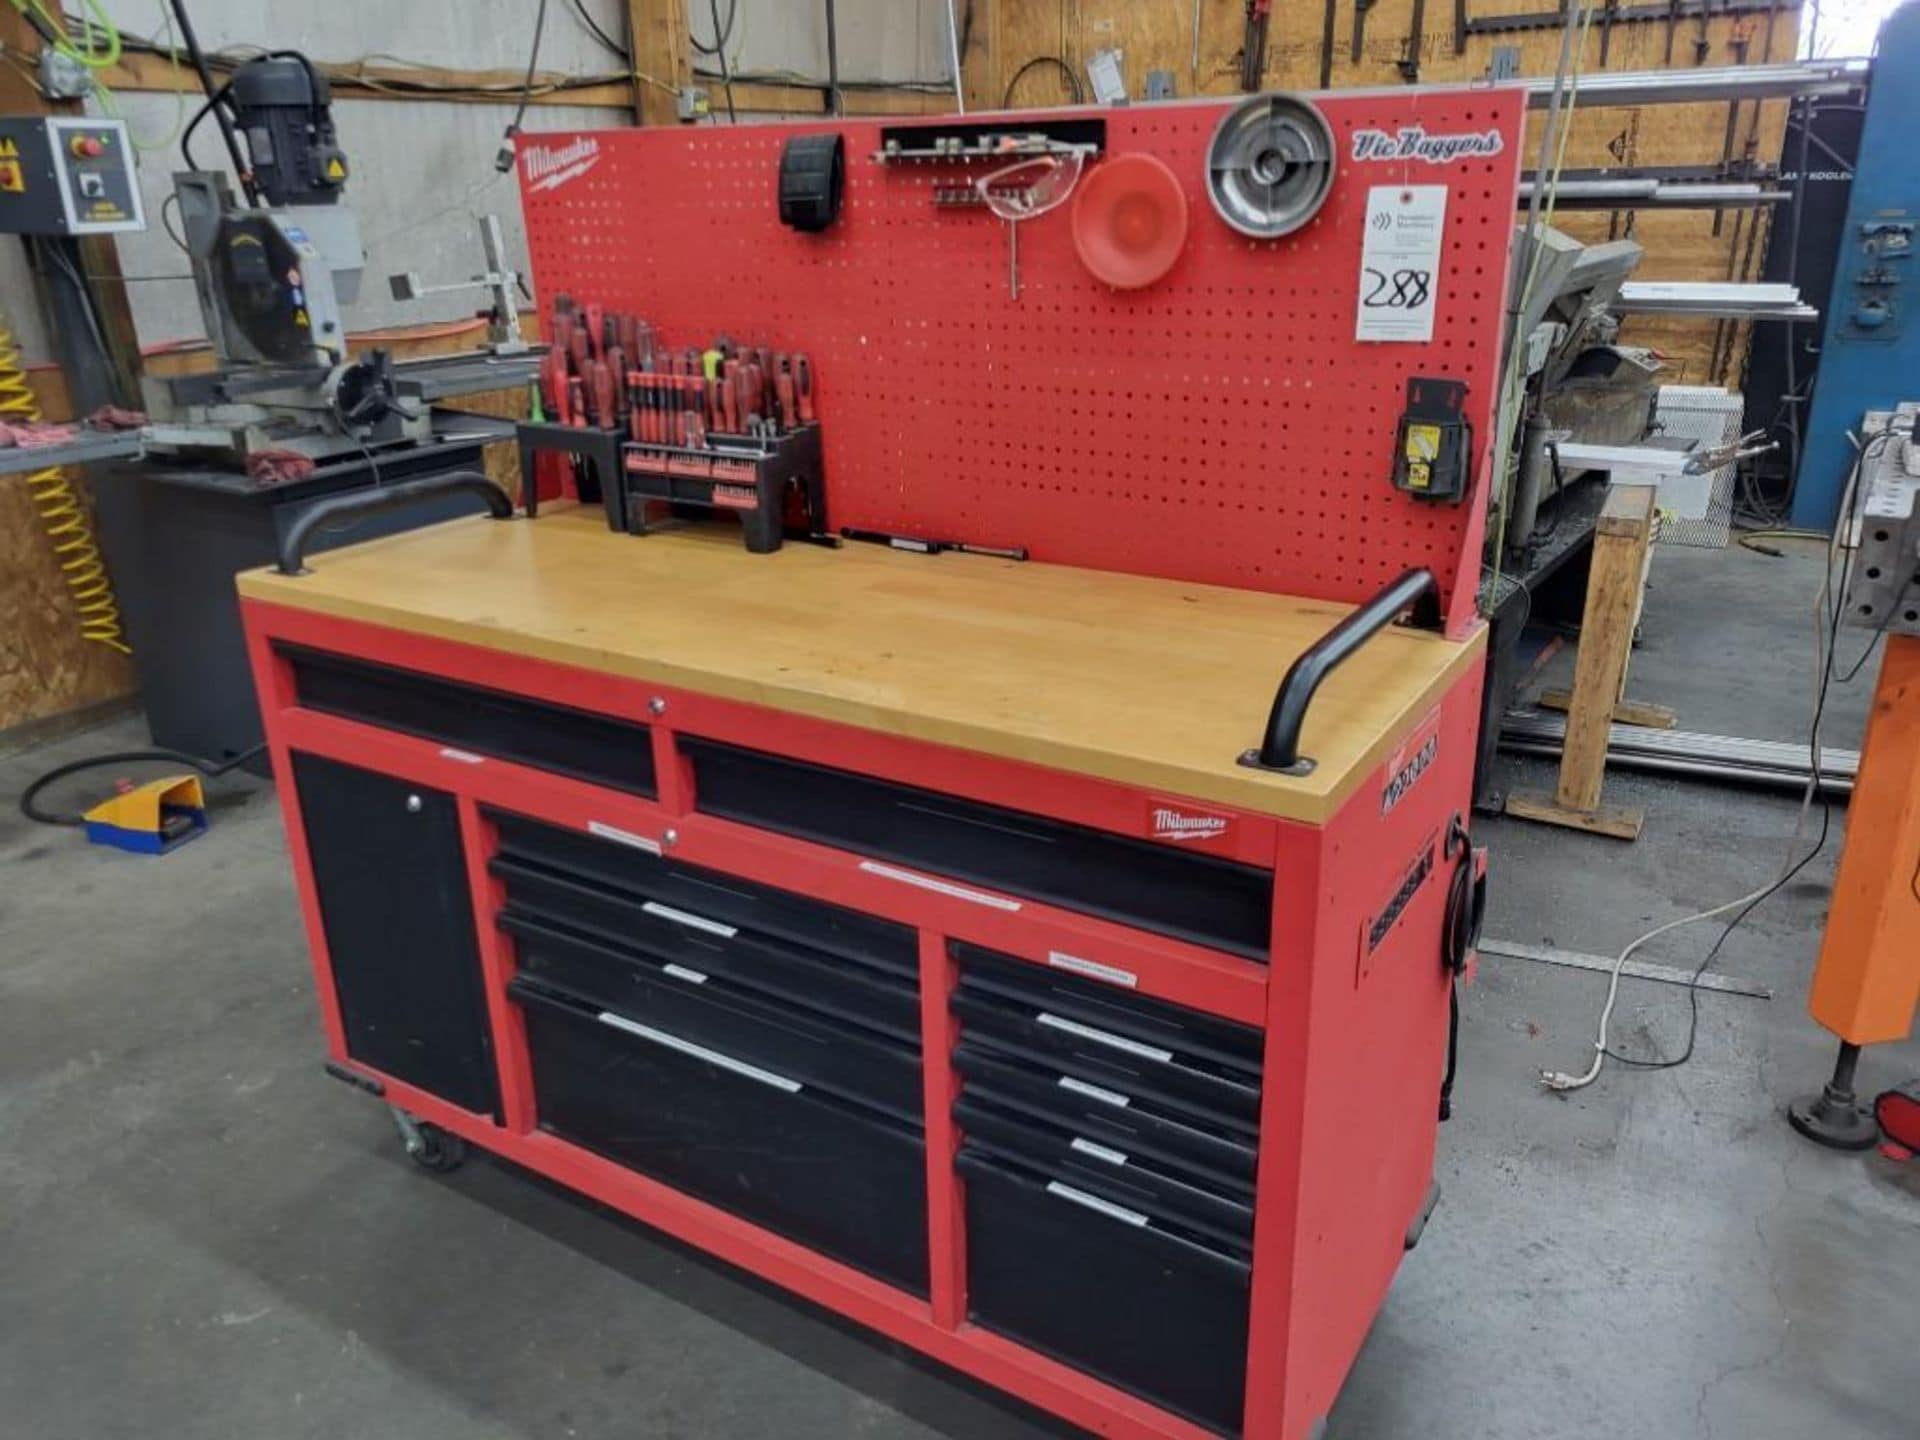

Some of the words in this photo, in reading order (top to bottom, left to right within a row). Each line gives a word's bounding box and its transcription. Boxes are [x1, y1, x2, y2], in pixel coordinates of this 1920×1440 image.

[523, 136, 600, 184] Milwaukee
[1353, 132, 1397, 161] Vic
[1397, 129, 1502, 161] Baggers
[1363, 267, 1431, 309] 288
[1153, 809, 1226, 832] Milwaukee
